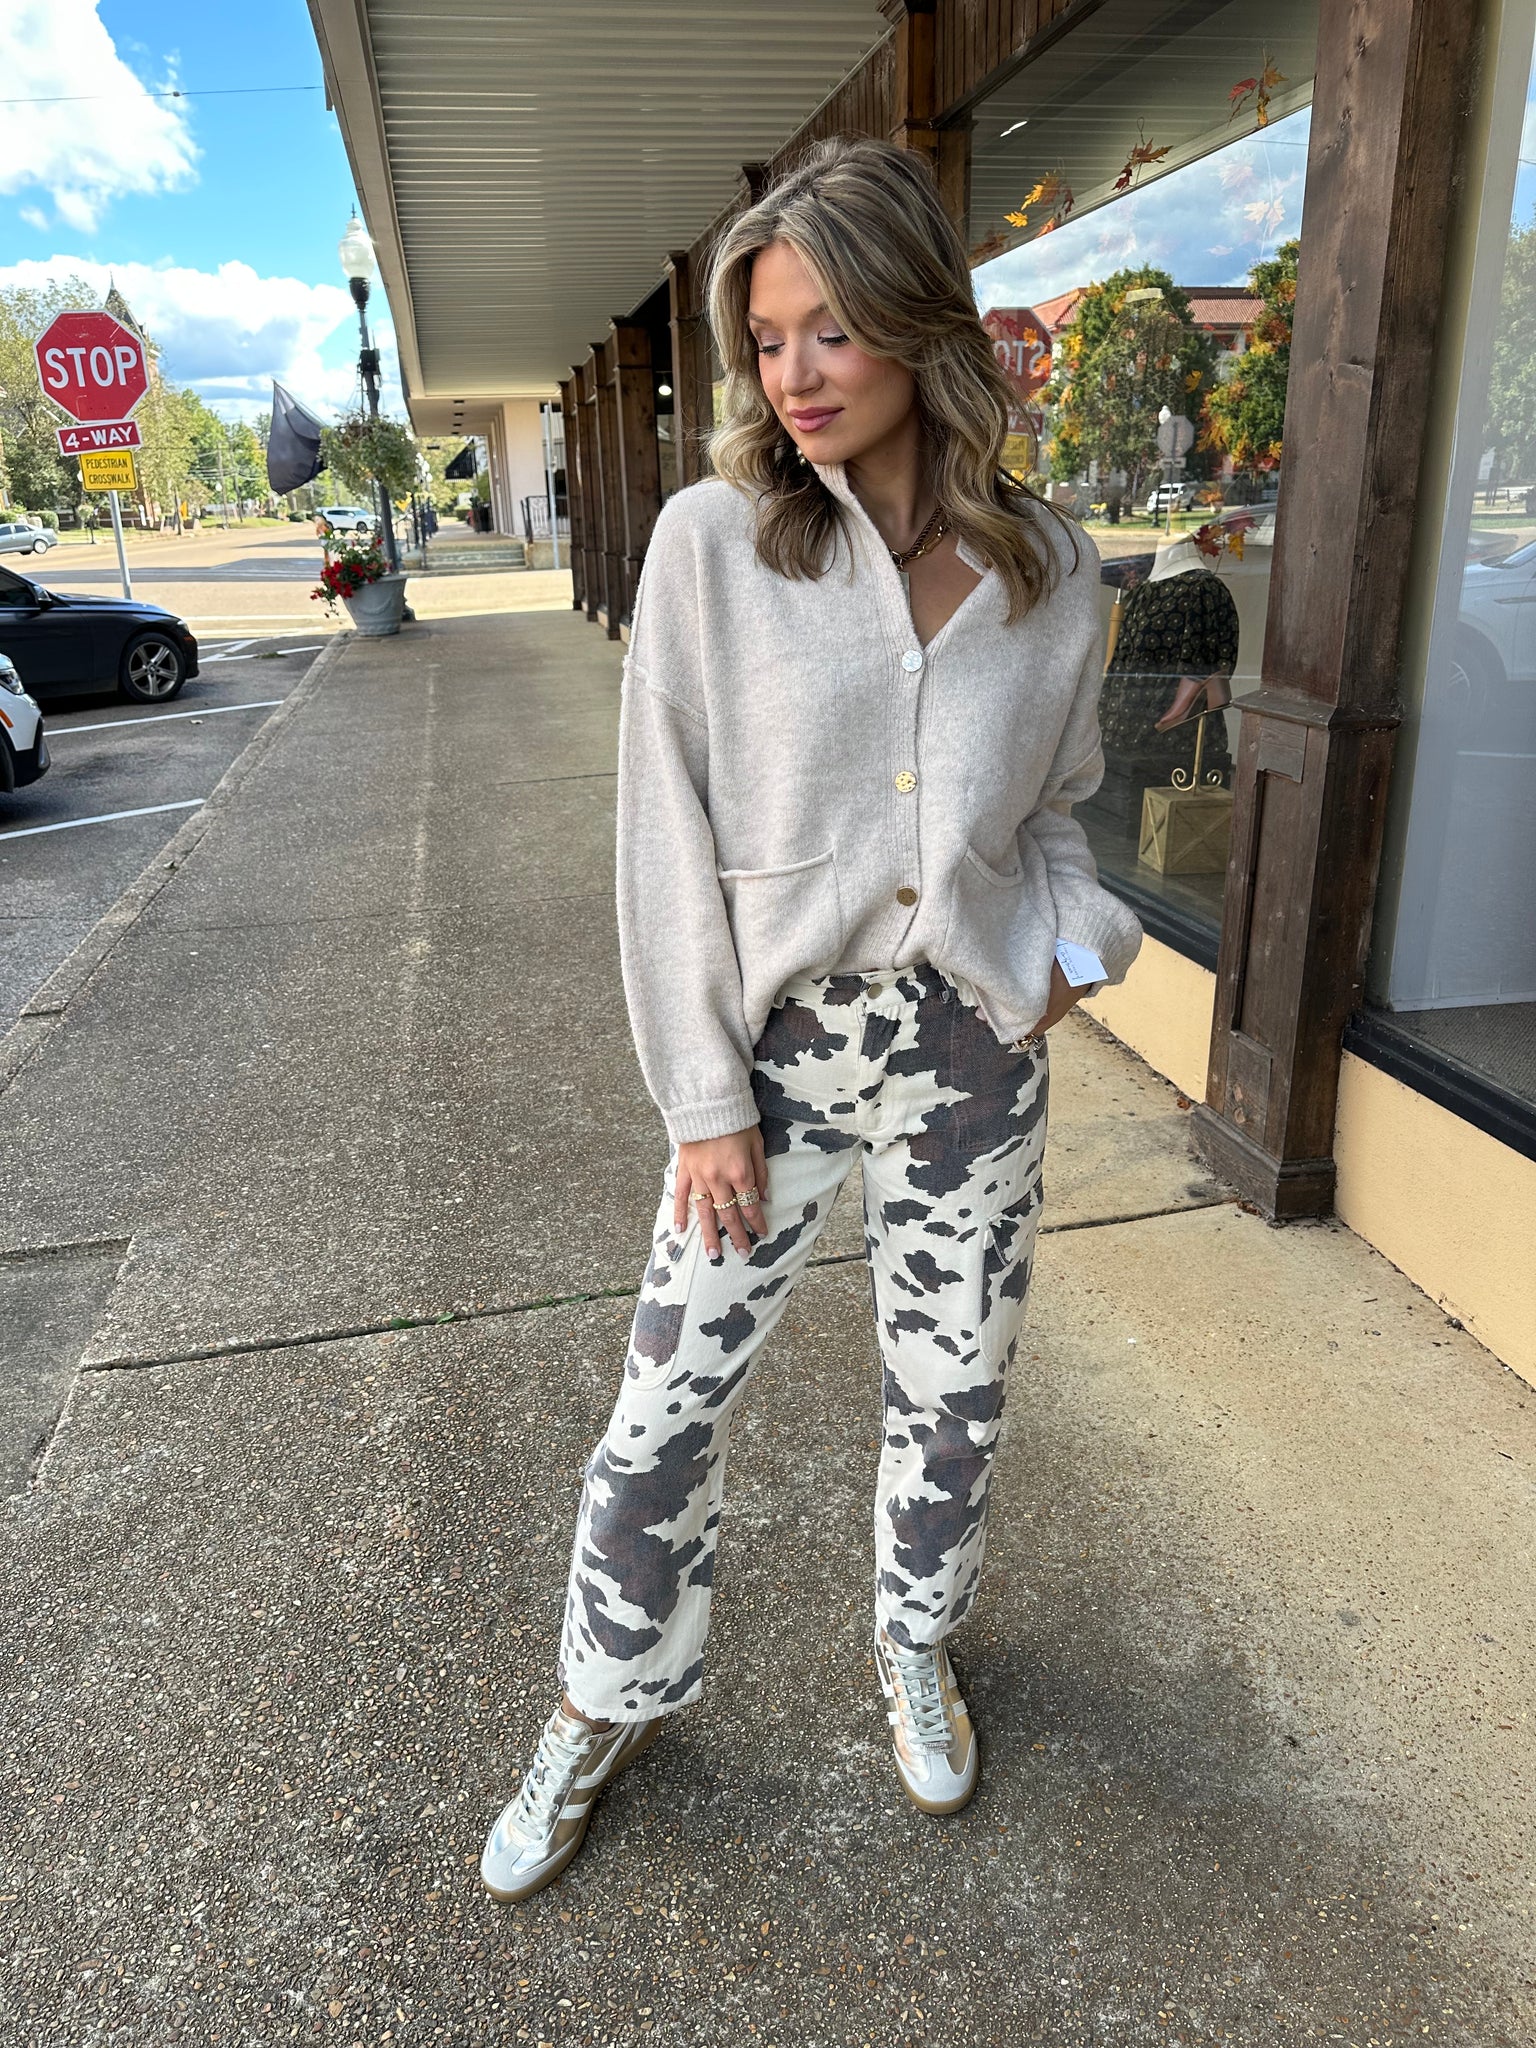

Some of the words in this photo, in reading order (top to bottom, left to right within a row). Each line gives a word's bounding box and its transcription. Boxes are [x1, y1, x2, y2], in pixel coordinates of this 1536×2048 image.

[45, 346, 137, 388] STOP
[65, 426, 132, 448] 4-WAY
[85, 457, 128, 469] PEDESTRIAN
[88, 472, 131, 485] CROSSWALK
